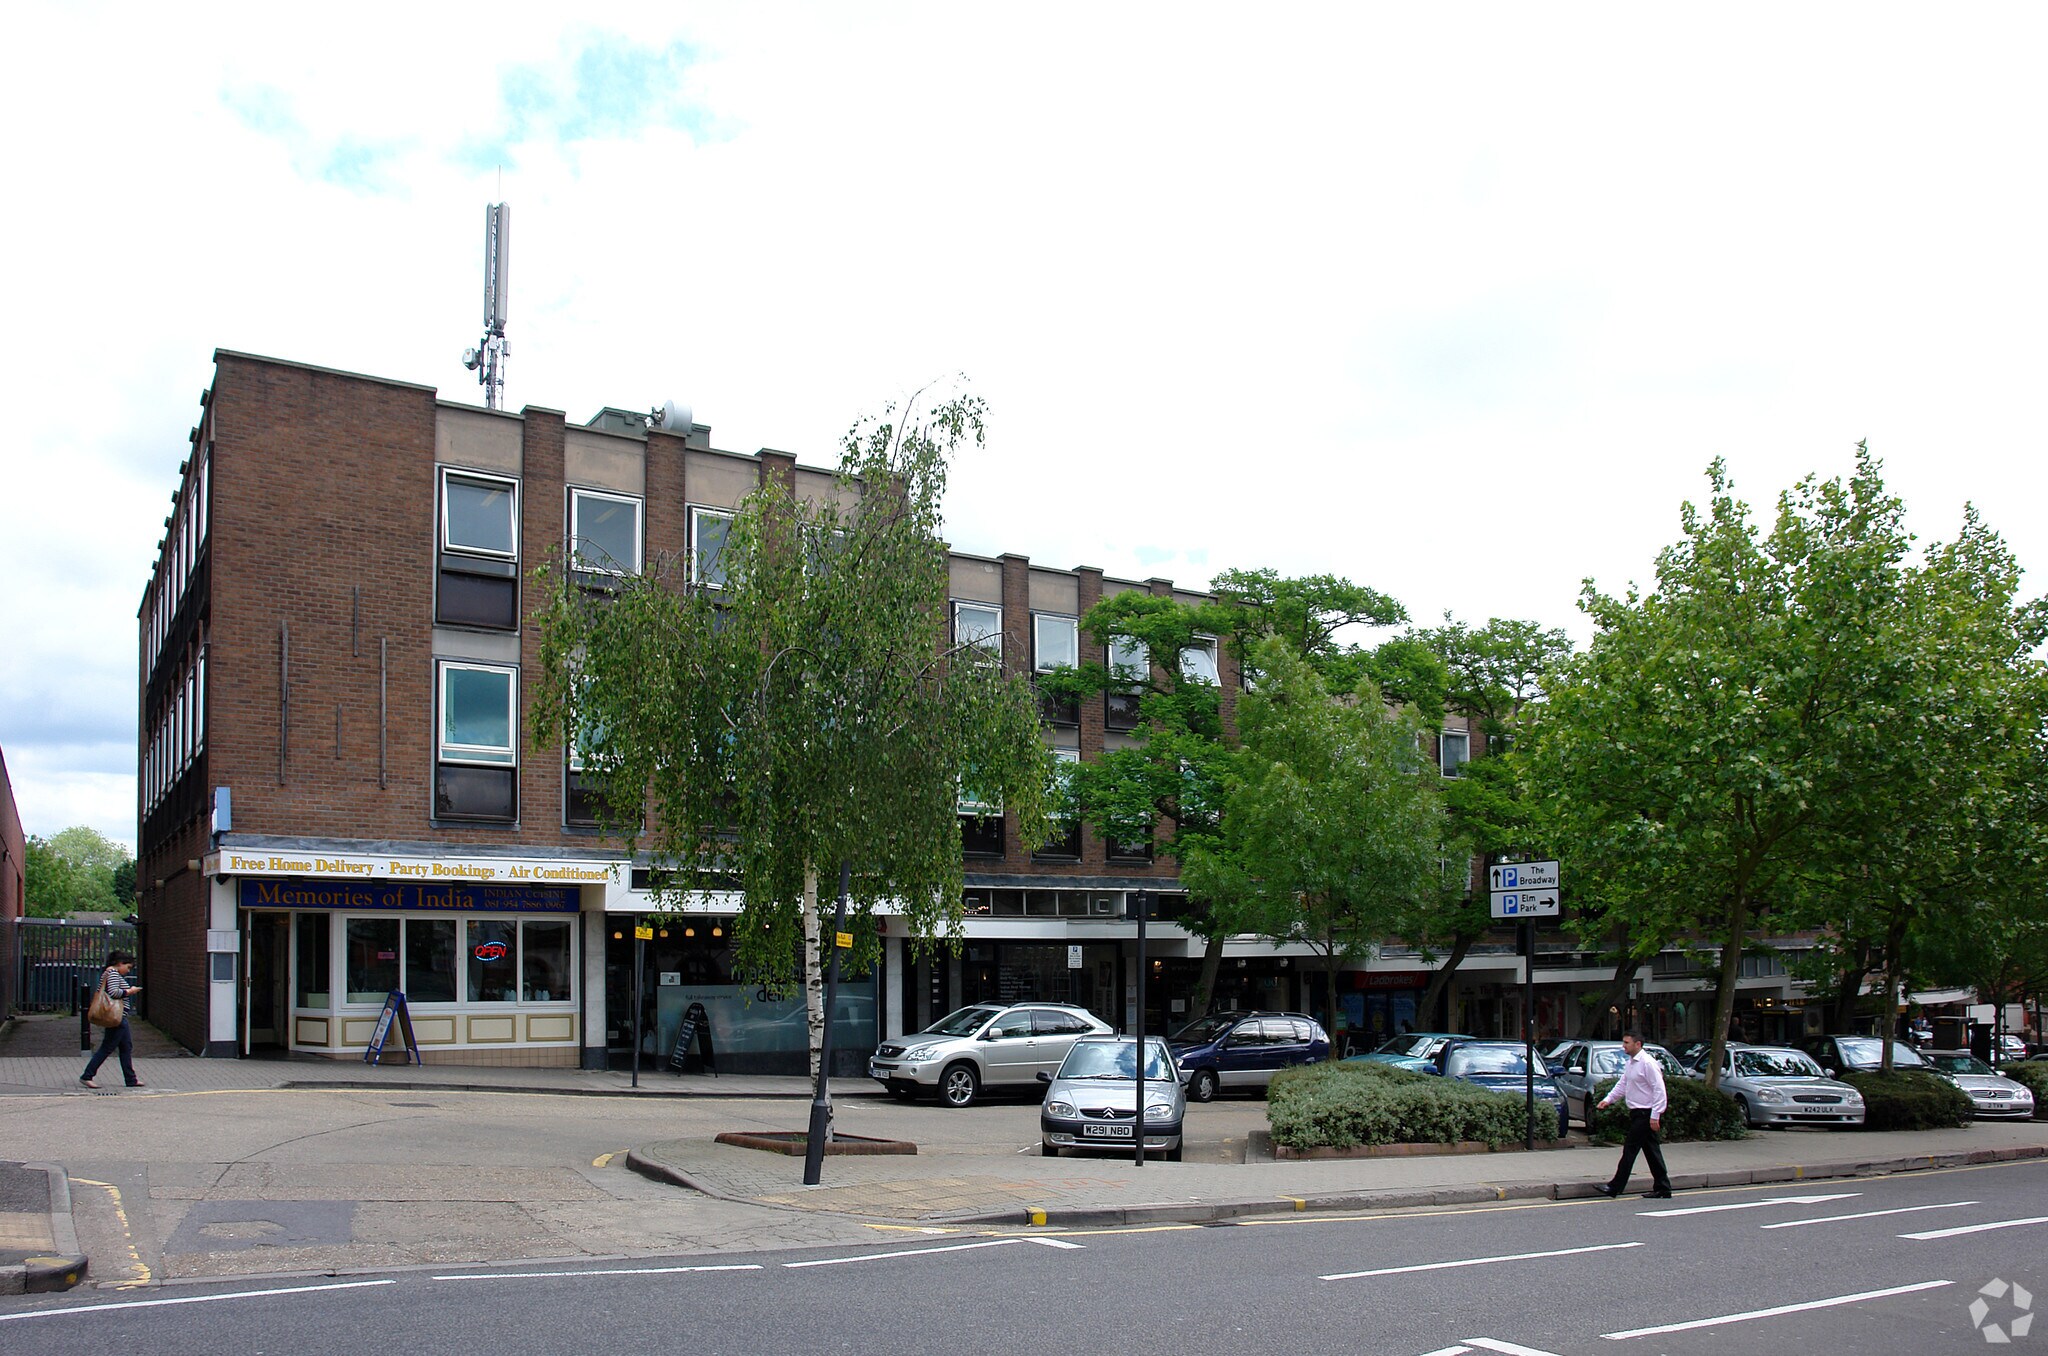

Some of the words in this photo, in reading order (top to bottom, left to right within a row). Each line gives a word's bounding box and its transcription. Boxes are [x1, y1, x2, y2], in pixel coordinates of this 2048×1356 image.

[230, 856, 266, 870] Free
[268, 857, 312, 872] Home
[314, 859, 374, 876] Delivery
[389, 861, 429, 878] Party
[432, 863, 495, 879] Bookings
[508, 865, 531, 878] Air
[533, 866, 609, 880] Conditioned
[1520, 876, 1556, 885] Broadway
[257, 883, 373, 906] Memories
[382, 886, 405, 906] of
[416, 887, 474, 908] India
[484, 888, 522, 897] INDIAN
[525, 889, 567, 898] CUISINE
[1522, 894, 1536, 902] Elm
[503, 900, 518, 908] 954
[1520, 904, 1537, 912] Park
[474, 945, 507, 957] OPEN
[1369, 975, 1415, 985] Ladbrokes
[1085, 1125, 1107, 1135] W291
